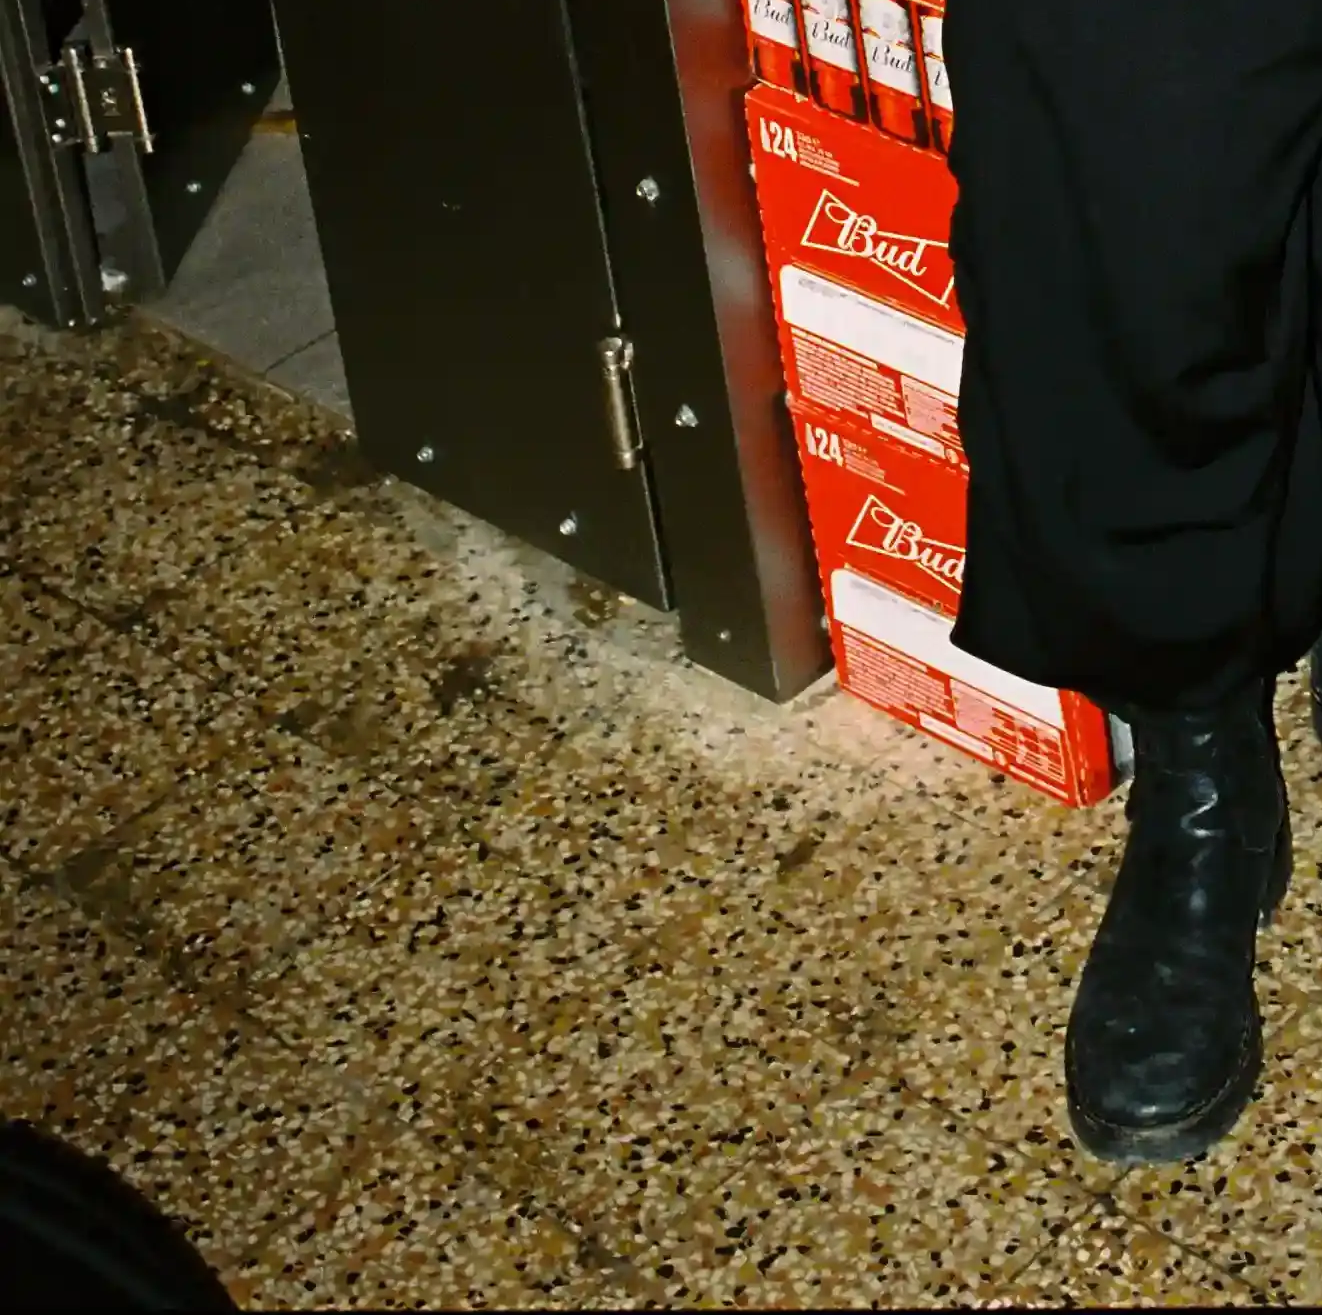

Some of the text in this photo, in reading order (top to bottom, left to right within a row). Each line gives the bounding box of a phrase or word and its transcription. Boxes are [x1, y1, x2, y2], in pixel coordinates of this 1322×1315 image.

[811, 18, 850, 50] Bud
[871, 44, 914, 75] Bud
[769, 121, 798, 163] 24
[825, 201, 928, 277] Bud
[815, 427, 844, 467] 24
[870, 506, 966, 584] Bud
